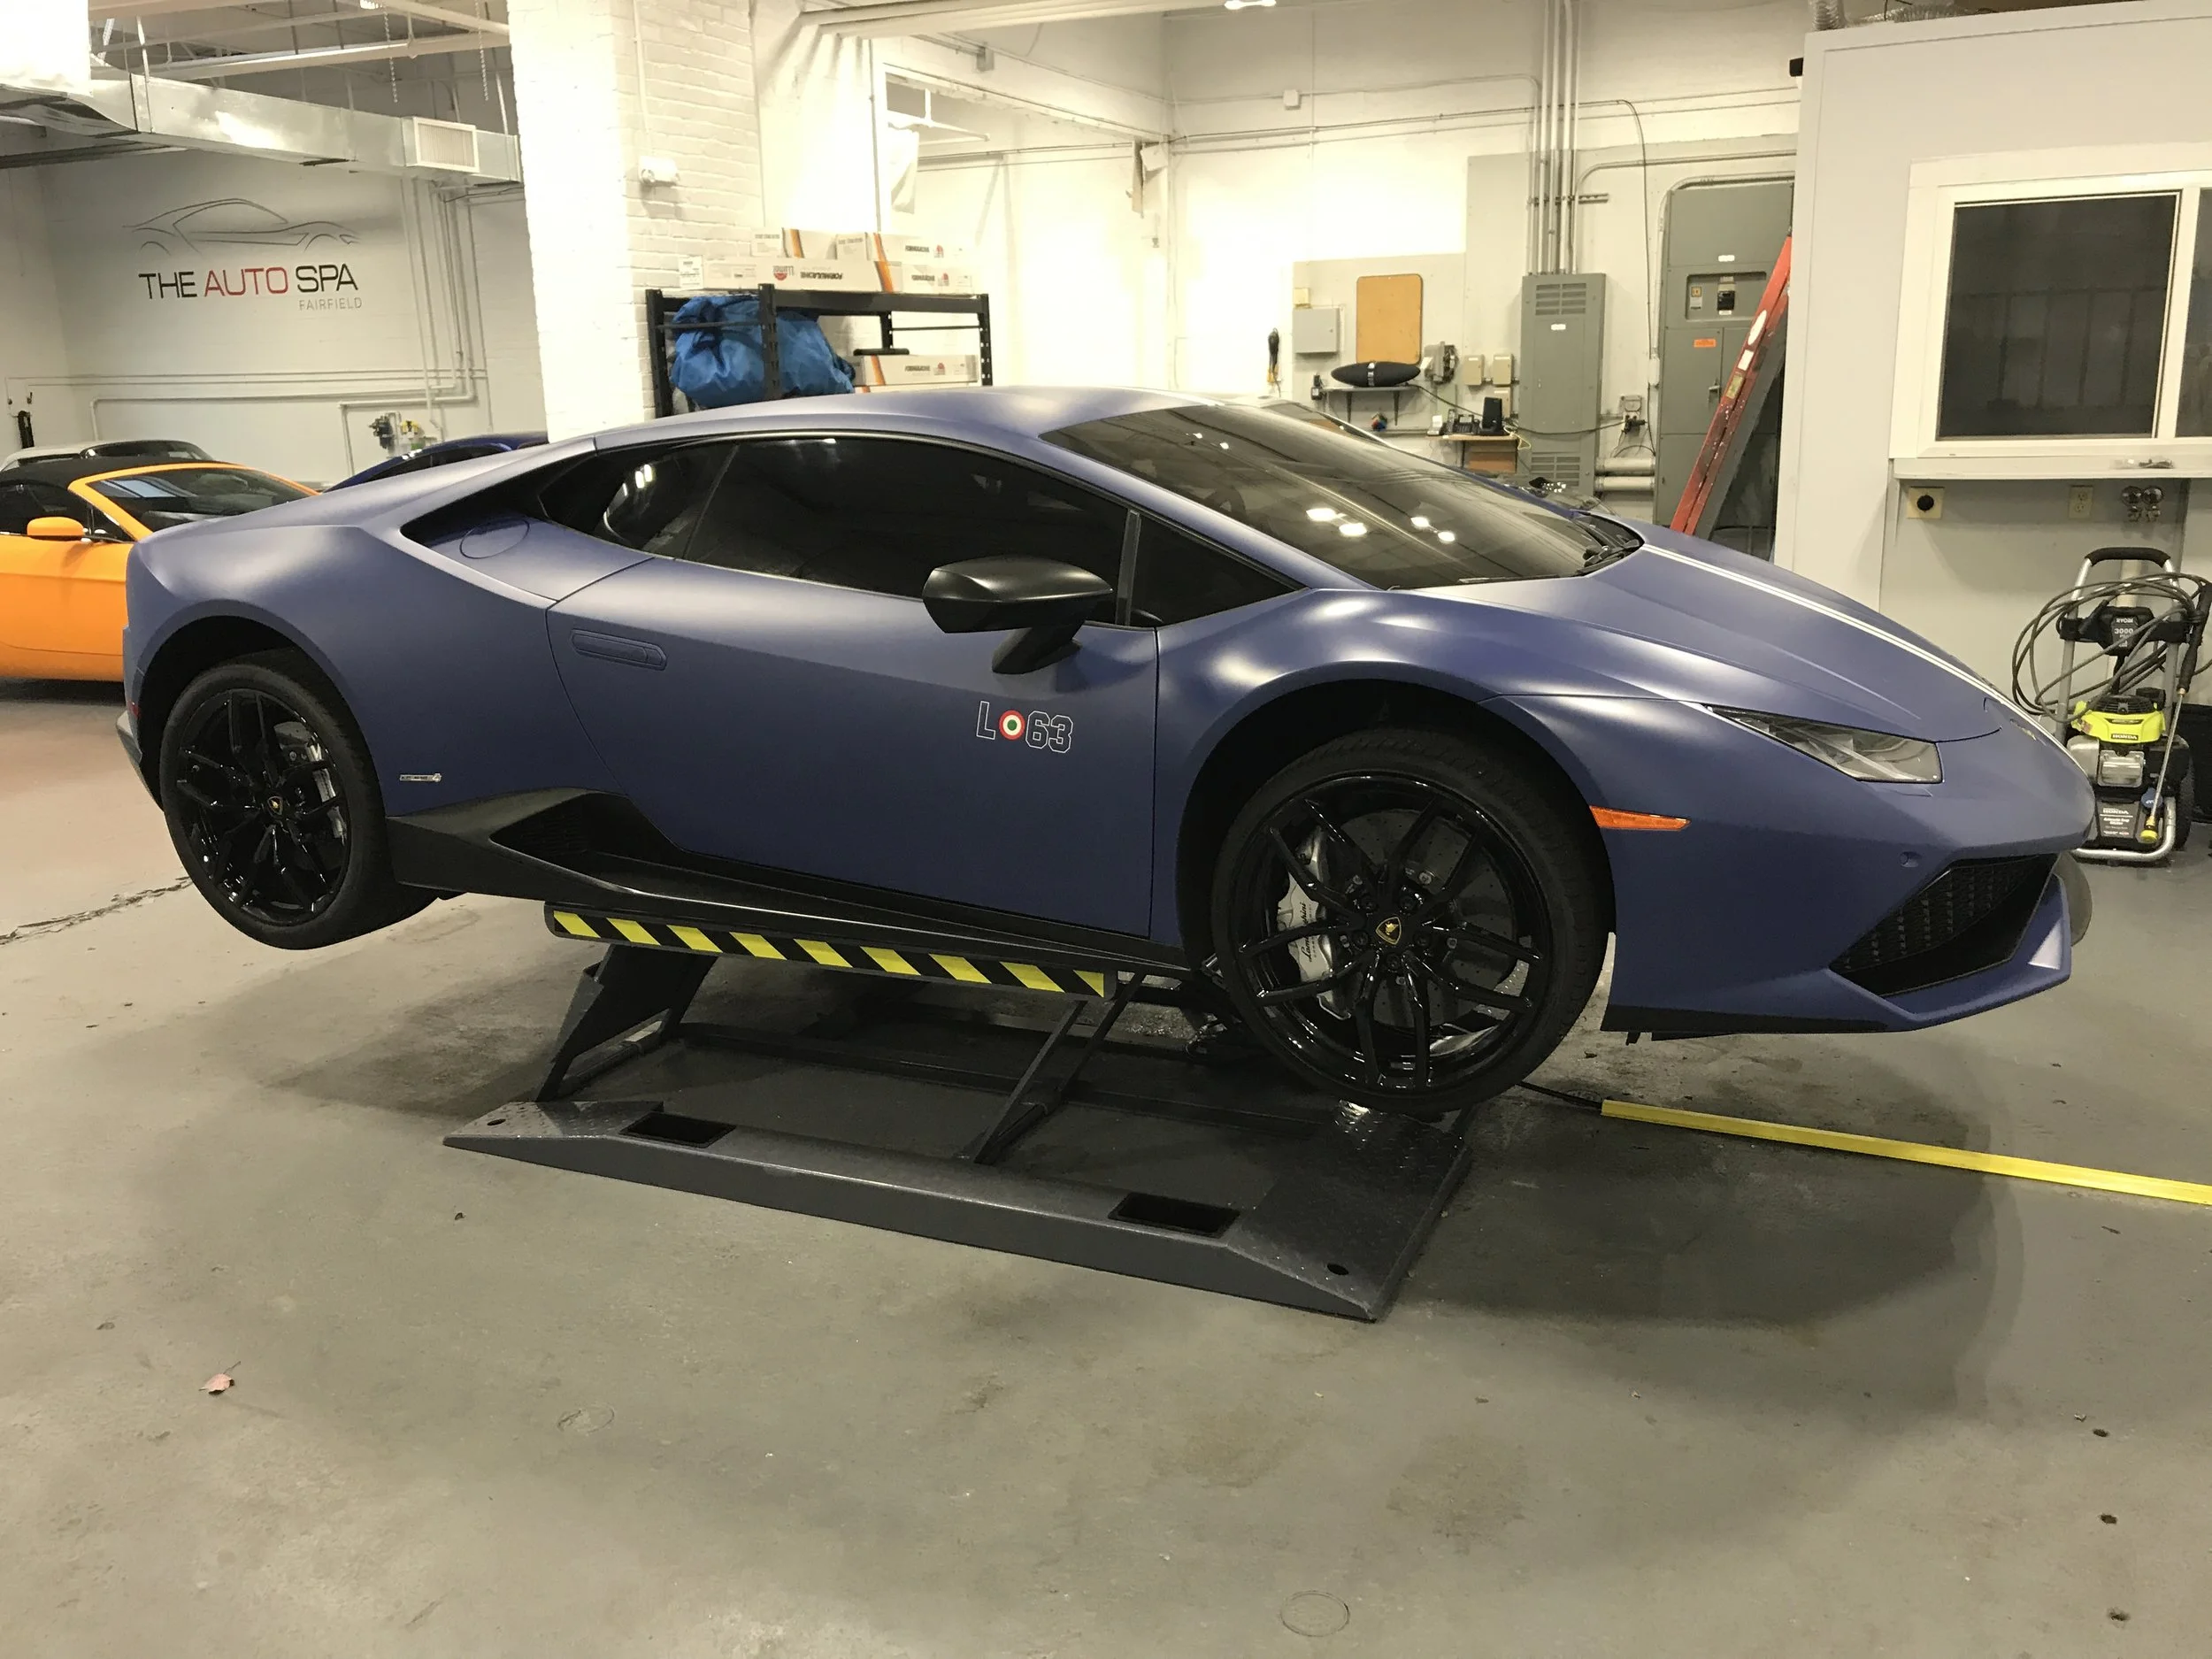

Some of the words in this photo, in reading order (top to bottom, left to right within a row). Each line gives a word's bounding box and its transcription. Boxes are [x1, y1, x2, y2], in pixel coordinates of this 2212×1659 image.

[138, 271, 197, 299] THE
[204, 267, 288, 297] AUTO
[296, 264, 358, 293] SPA
[298, 296, 363, 311] FAIRFIELD
